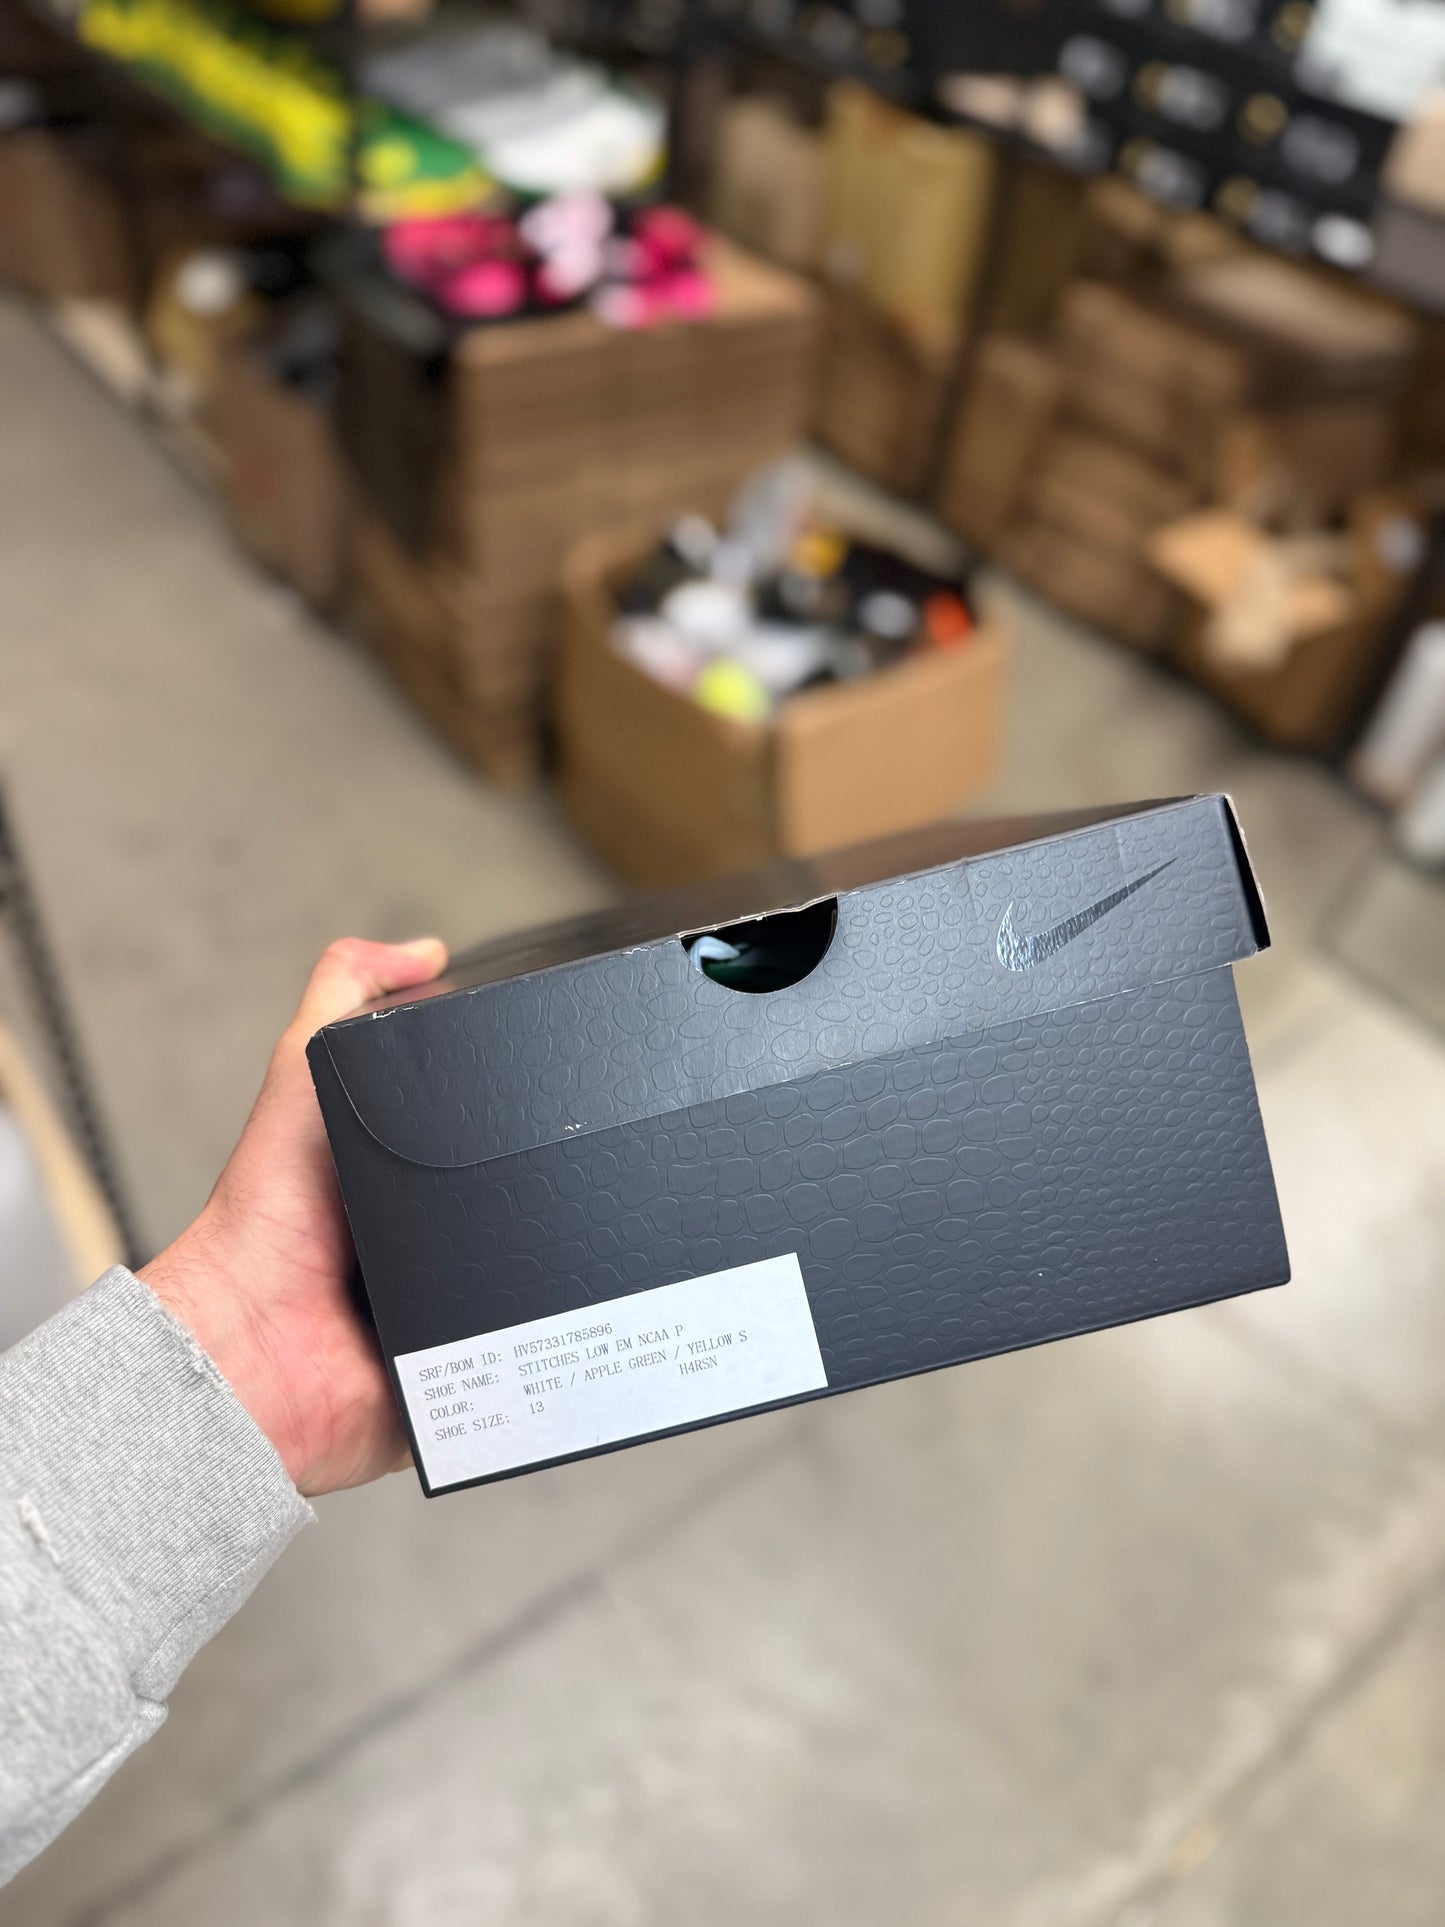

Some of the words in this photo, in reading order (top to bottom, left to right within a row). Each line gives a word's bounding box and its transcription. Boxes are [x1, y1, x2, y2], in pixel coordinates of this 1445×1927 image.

[419, 1357, 474, 1382] SRF/BOM
[482, 1352, 502, 1366] ID:
[513, 1323, 613, 1358] HV57331785896
[424, 1383, 456, 1400] SHOE
[462, 1373, 500, 1391] NAME:
[518, 1351, 580, 1376] STITCHES
[586, 1343, 609, 1359] LOW
[616, 1337, 633, 1352] EM
[638, 1329, 670, 1346] NCAA
[675, 1324, 683, 1337] P
[430, 1401, 474, 1420] COLOR:
[523, 1376, 563, 1396] WHITE
[570, 1372, 575, 1386] /
[584, 1361, 623, 1381] APPLE
[628, 1350, 667, 1370] GREEN
[675, 1345, 680, 1360] /
[687, 1333, 733, 1355] YELLOW
[739, 1330, 748, 1342] S
[679, 1355, 718, 1375] H4RSN
[435, 1423, 467, 1441] SHOE
[472, 1413, 510, 1431] SIZE:
[529, 1401, 545, 1415] 13
